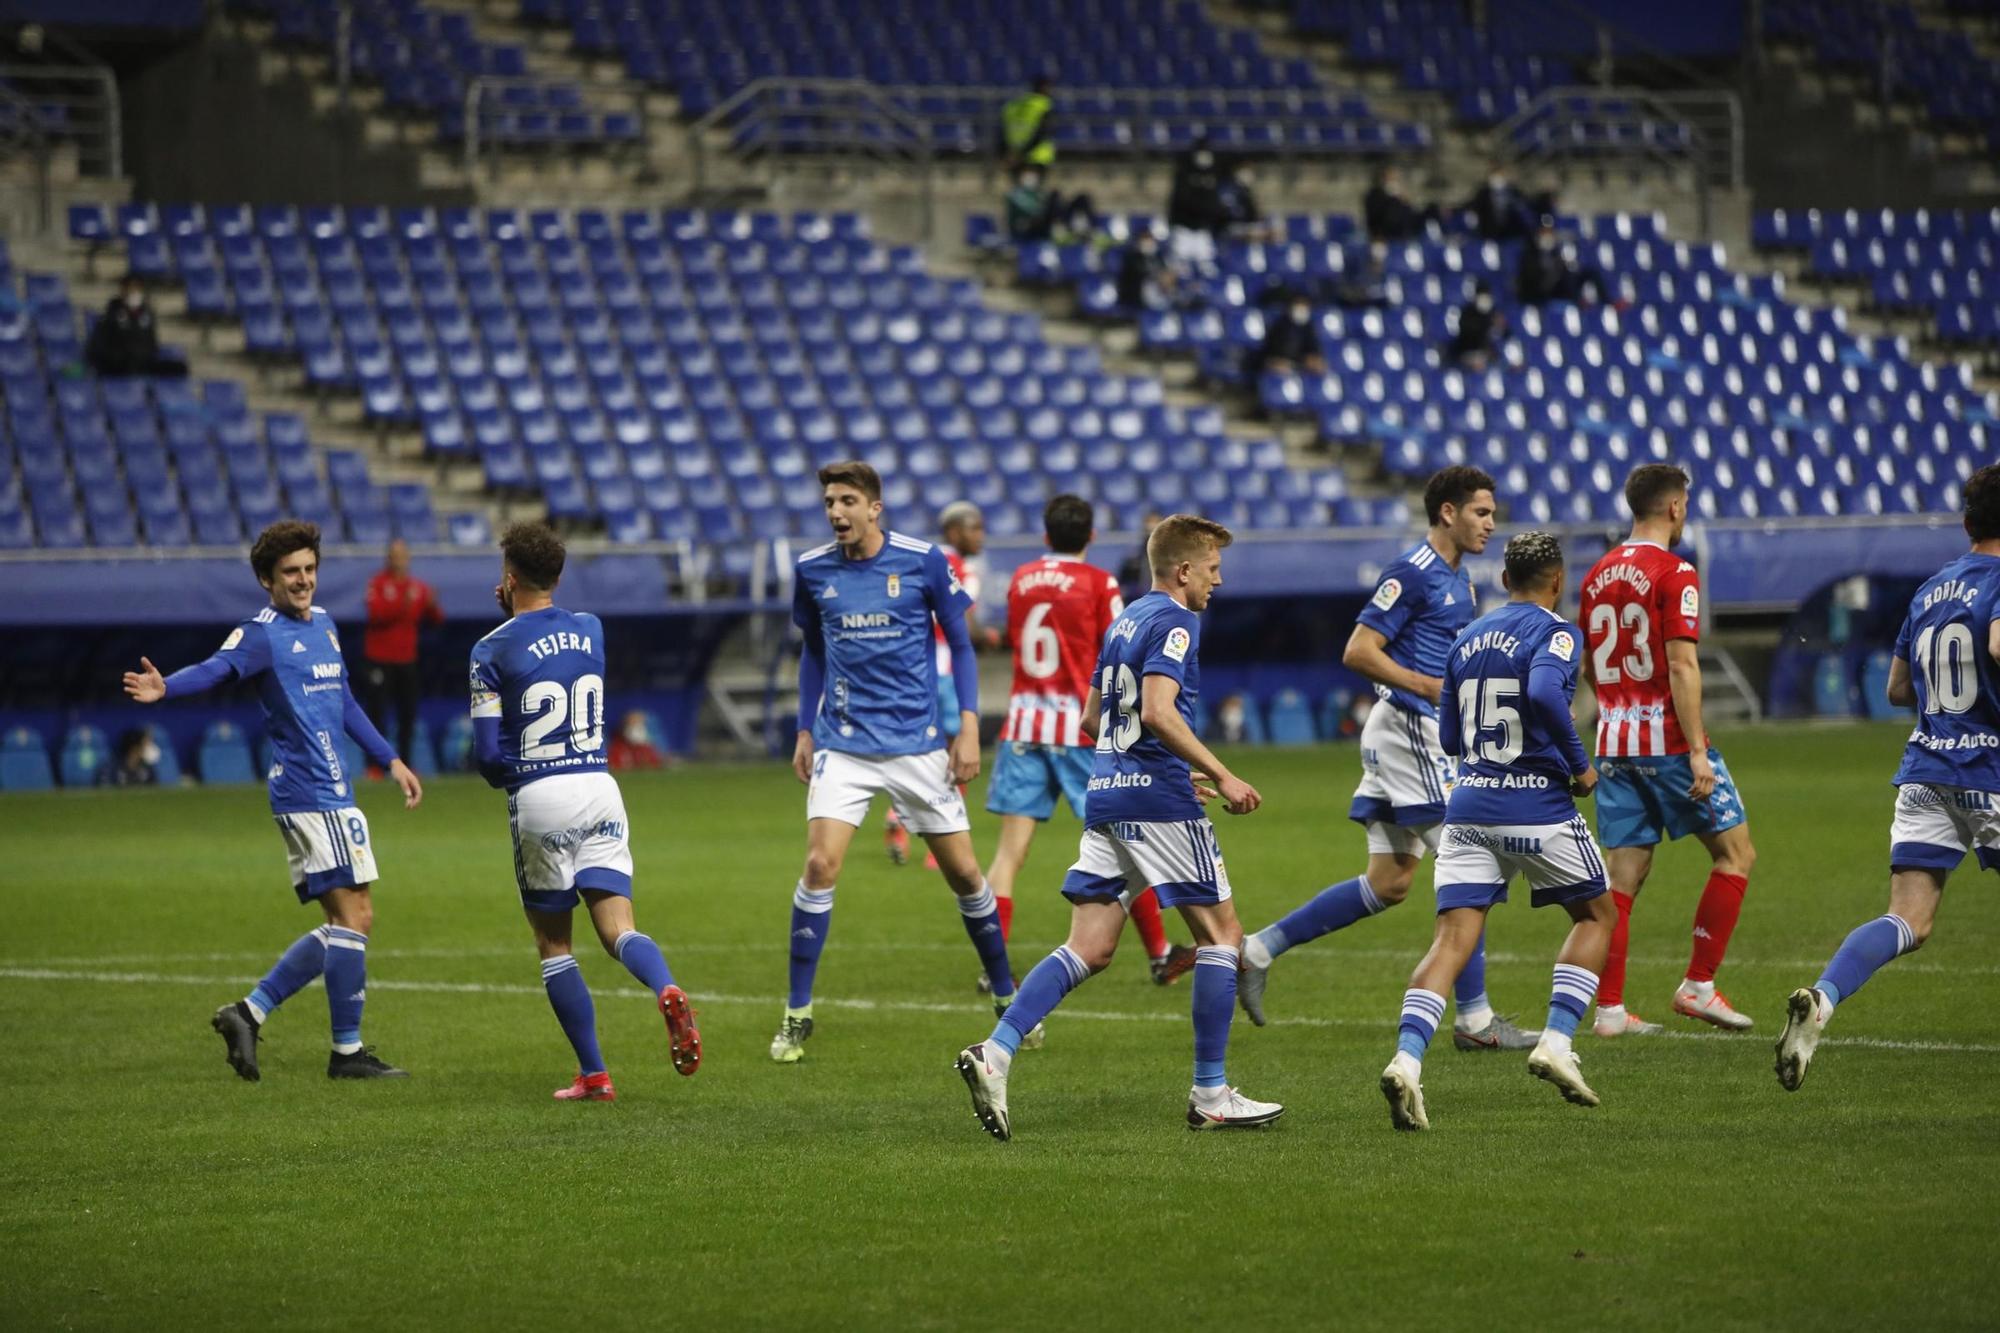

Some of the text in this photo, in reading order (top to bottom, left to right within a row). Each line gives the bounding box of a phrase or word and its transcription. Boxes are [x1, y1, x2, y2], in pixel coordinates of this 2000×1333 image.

[1587, 563, 1652, 600] F.VENANCIO
[841, 614, 890, 629] NMR
[528, 632, 592, 660] TEJERA
[1021, 602, 1059, 679] 6
[1459, 630, 1521, 661] NAHUEL
[1589, 602, 1654, 685] 23
[312, 663, 342, 679] NMR
[1915, 622, 1979, 714] 10
[520, 673, 606, 760] 20
[1458, 677, 1524, 766] 15
[1956, 732, 1999, 749] Auto
[1110, 771, 1152, 788] Auto
[1501, 772, 1549, 789] Auto
[348, 816, 366, 846] 8
[1503, 836, 1543, 854] HILL
